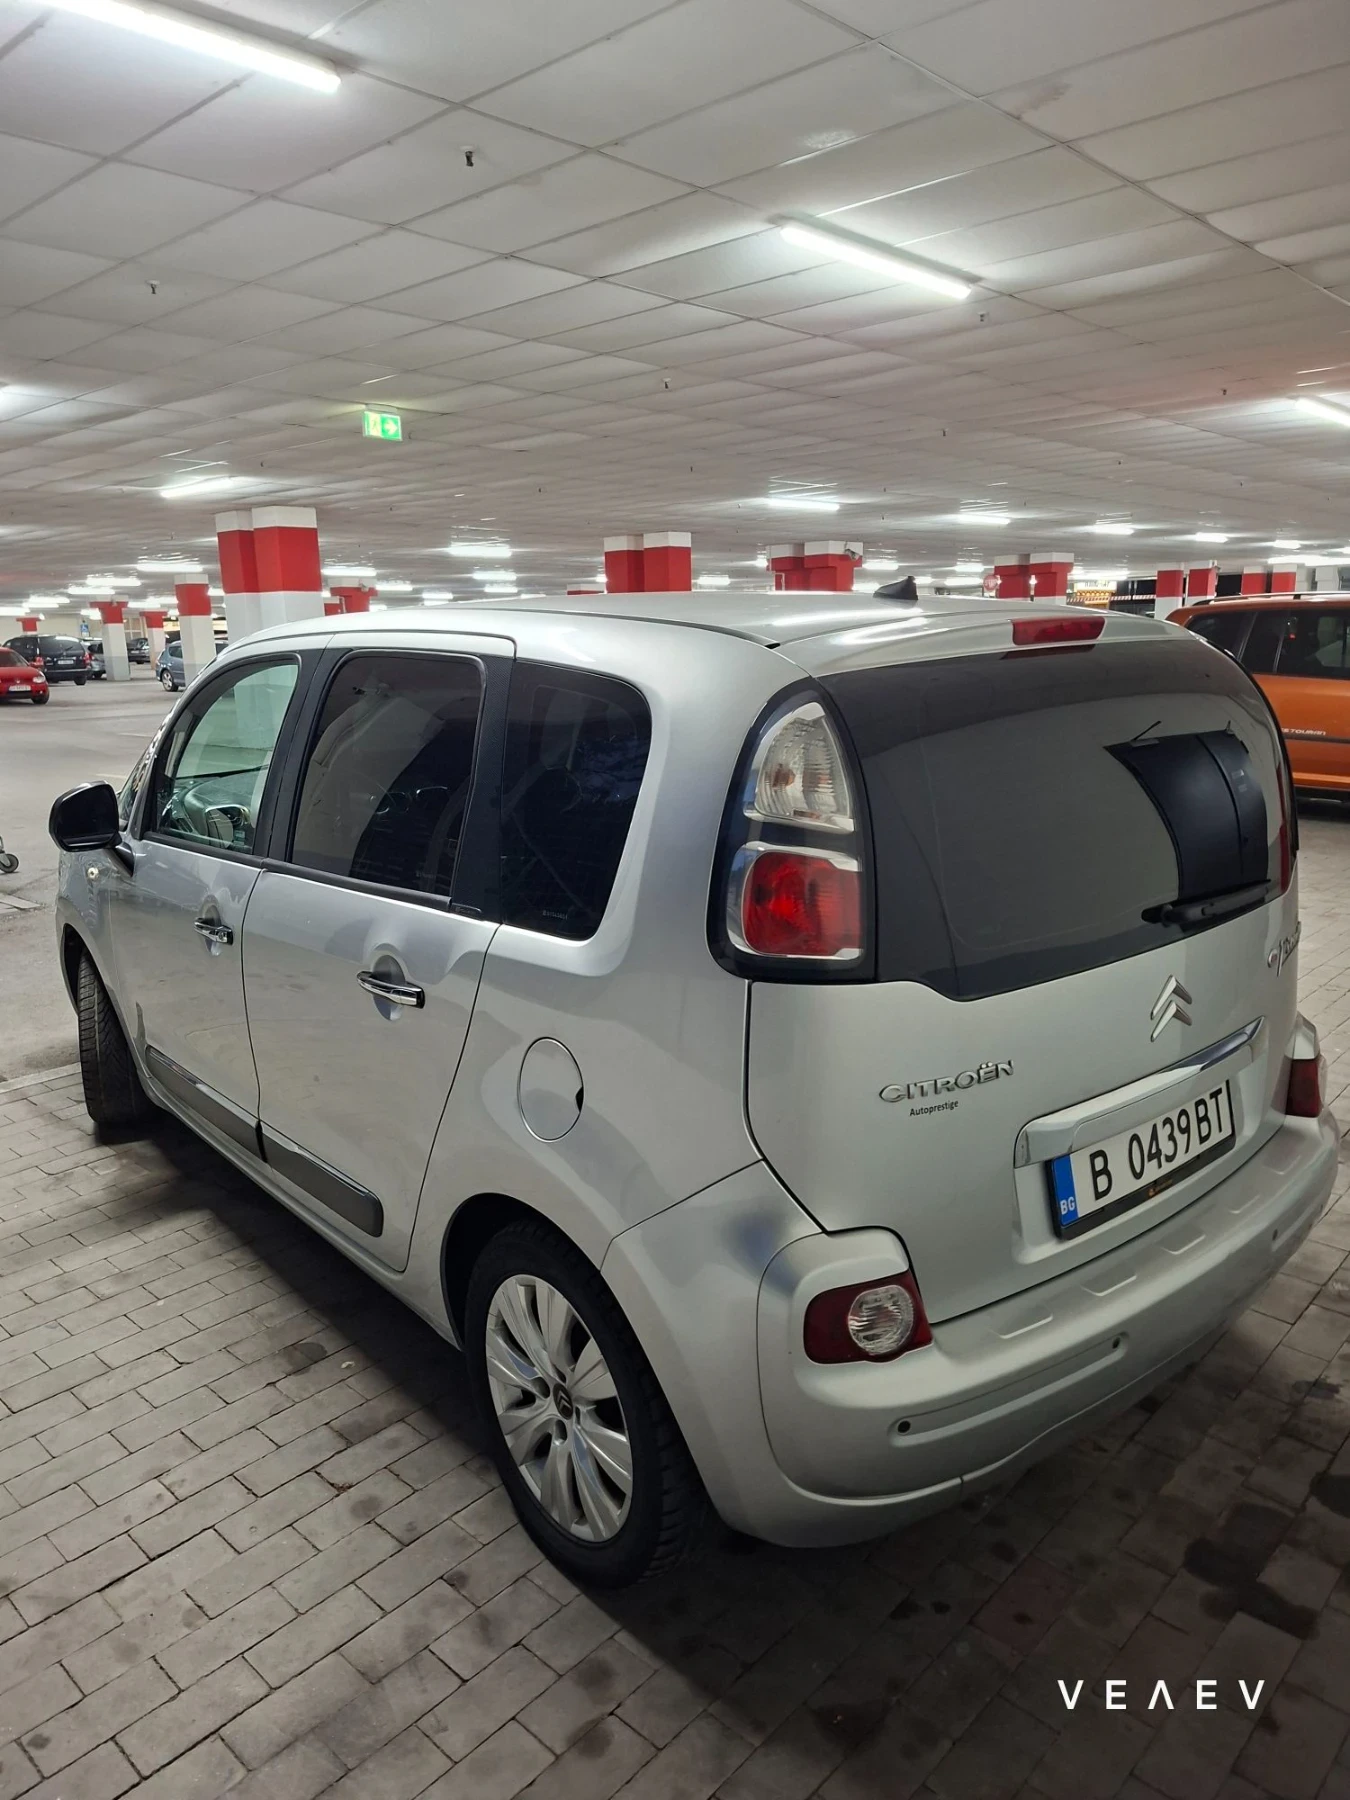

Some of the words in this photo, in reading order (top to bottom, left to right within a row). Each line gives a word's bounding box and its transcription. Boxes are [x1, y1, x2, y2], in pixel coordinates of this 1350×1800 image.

[879, 1060, 1014, 1102] CITROËN
[909, 1100, 959, 1117] Autoprestige
[1089, 1149, 1113, 1201] B
[1060, 1196, 1076, 1215] BG
